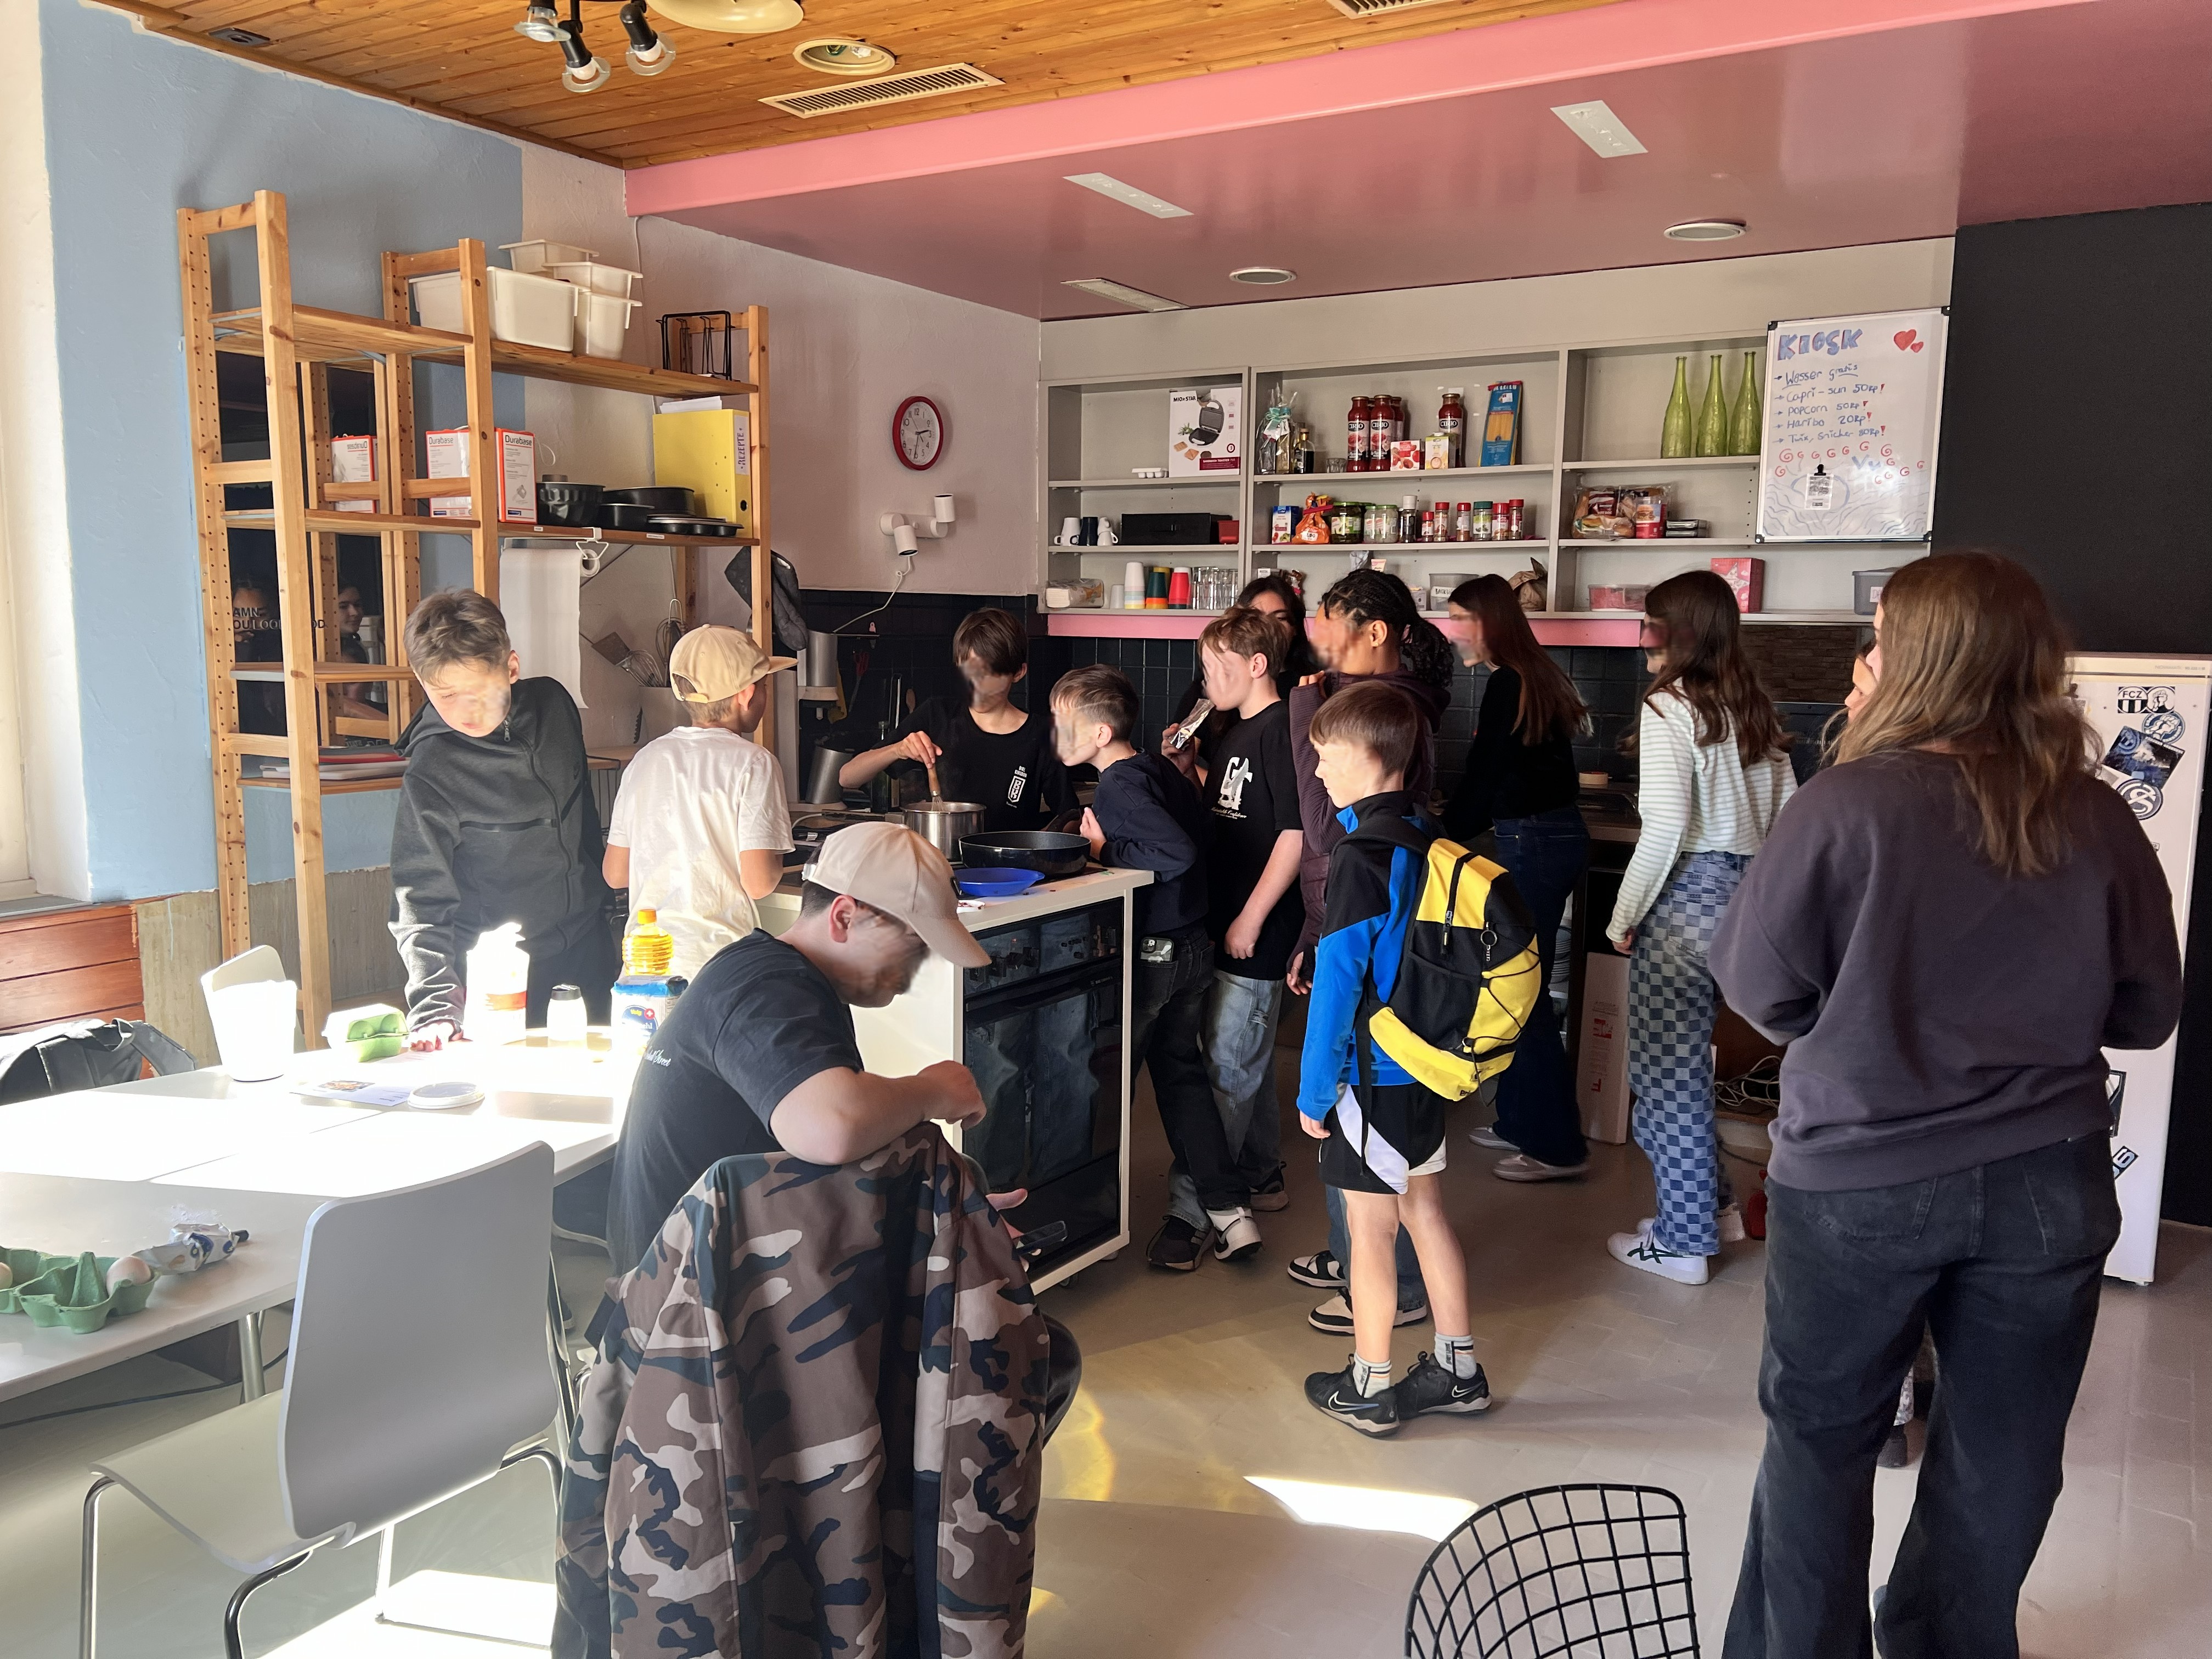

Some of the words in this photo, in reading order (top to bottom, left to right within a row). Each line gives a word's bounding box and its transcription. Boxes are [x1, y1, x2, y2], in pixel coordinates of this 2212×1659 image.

[1778, 329, 1863, 360] KIOSK
[1786, 370, 1822, 385] Wasser
[1829, 363, 1858, 381] gratis
[1787, 417, 1824, 428] Haribo
[429, 437, 454, 445] Durabase
[505, 435, 532, 445] Durabase
[737, 432, 746, 465] REZEPTE
[234, 607, 261, 617] AMN.
[234, 620, 249, 630] OU
[252, 619, 281, 630] LOO
